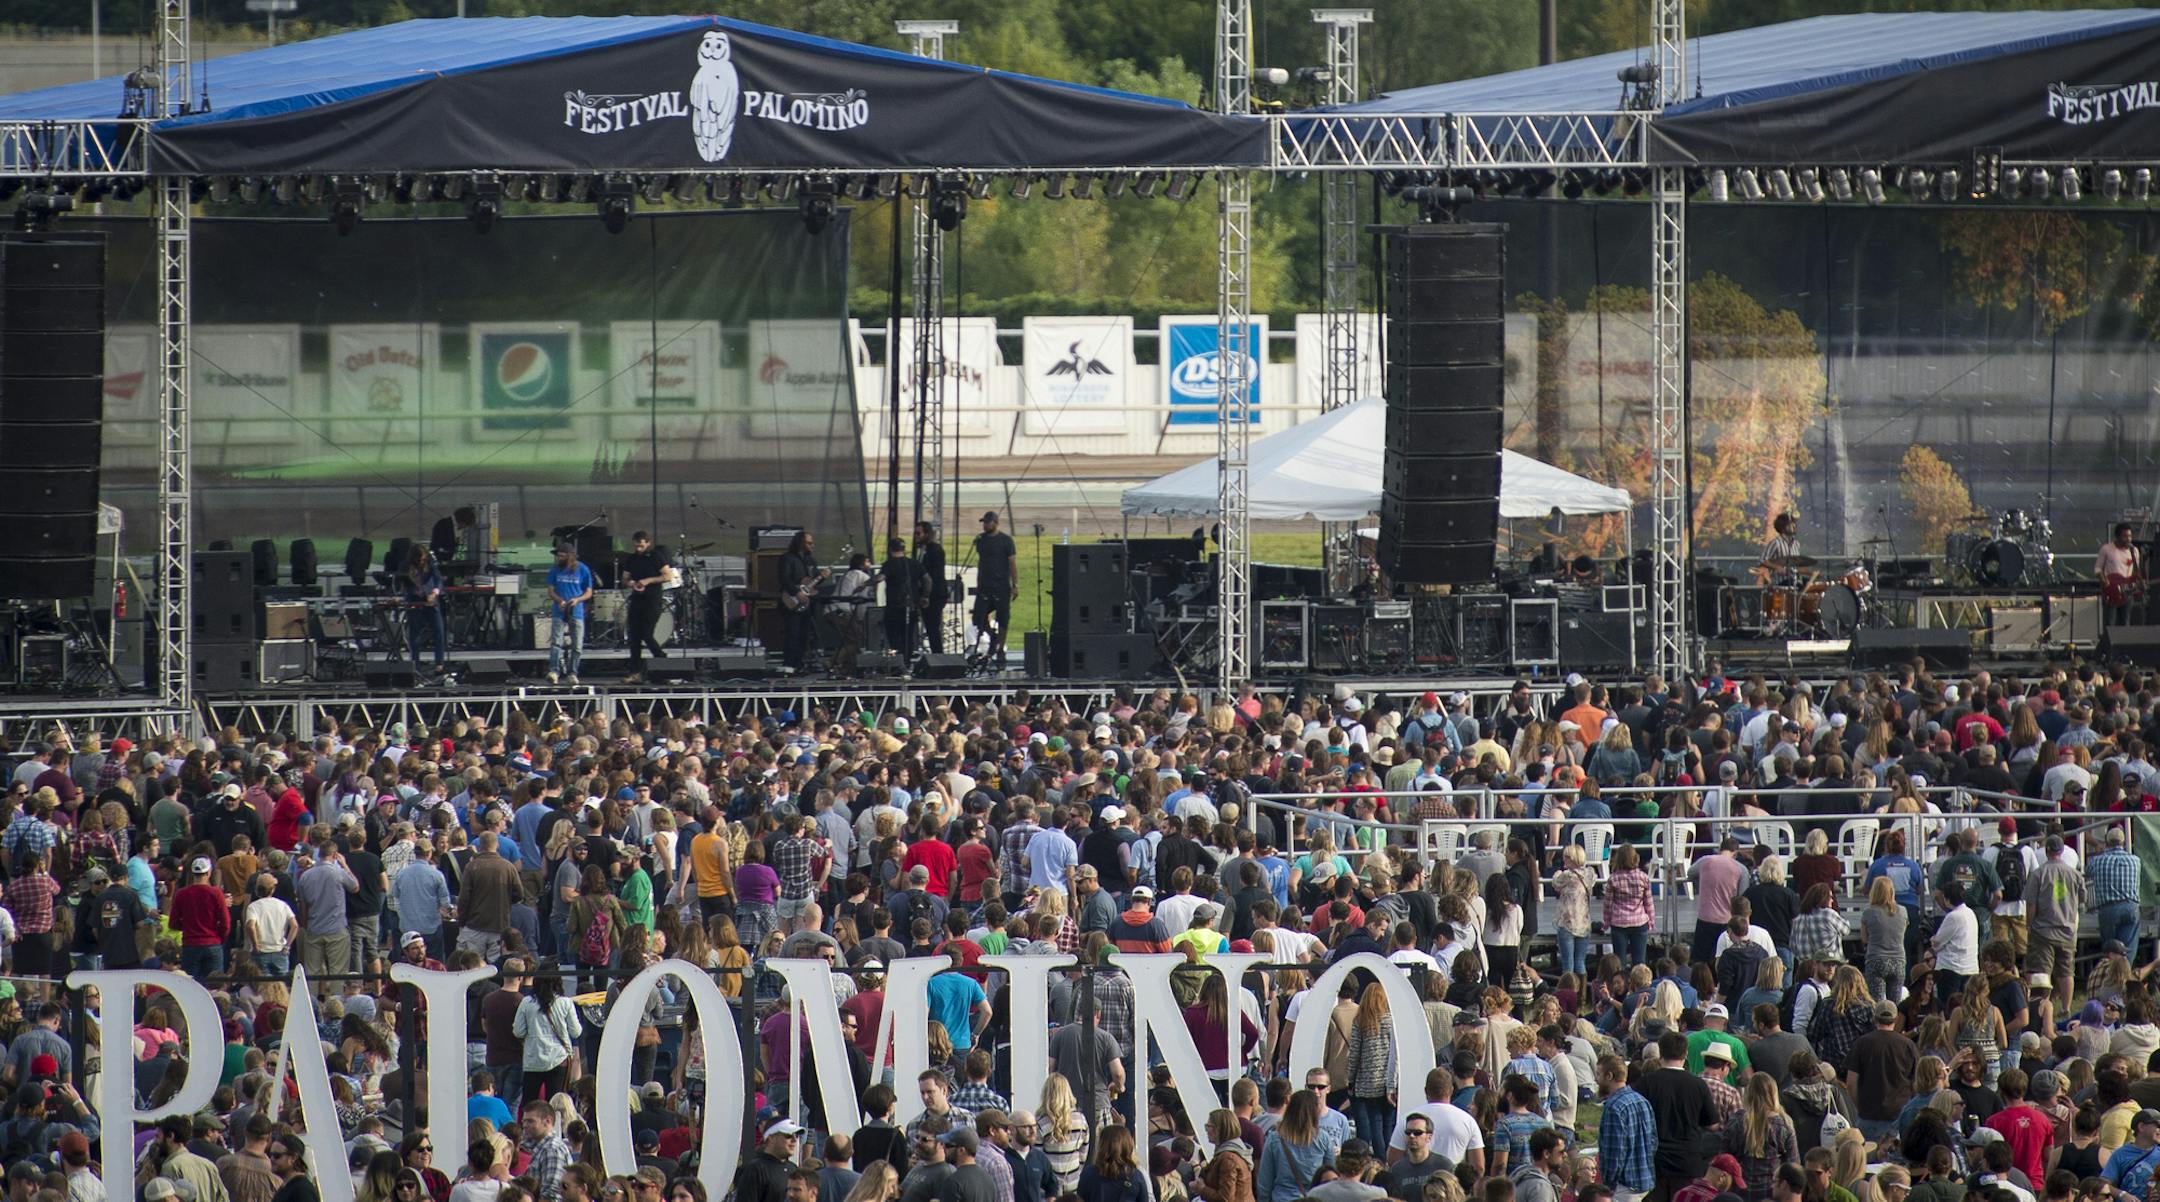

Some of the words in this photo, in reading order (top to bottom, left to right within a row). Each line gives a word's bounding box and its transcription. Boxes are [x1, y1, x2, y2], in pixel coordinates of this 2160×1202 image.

[563, 92, 688, 134] FESTIVAL
[743, 91, 869, 131] PALOMINO
[2047, 82, 2160, 125] FESTIVAL
